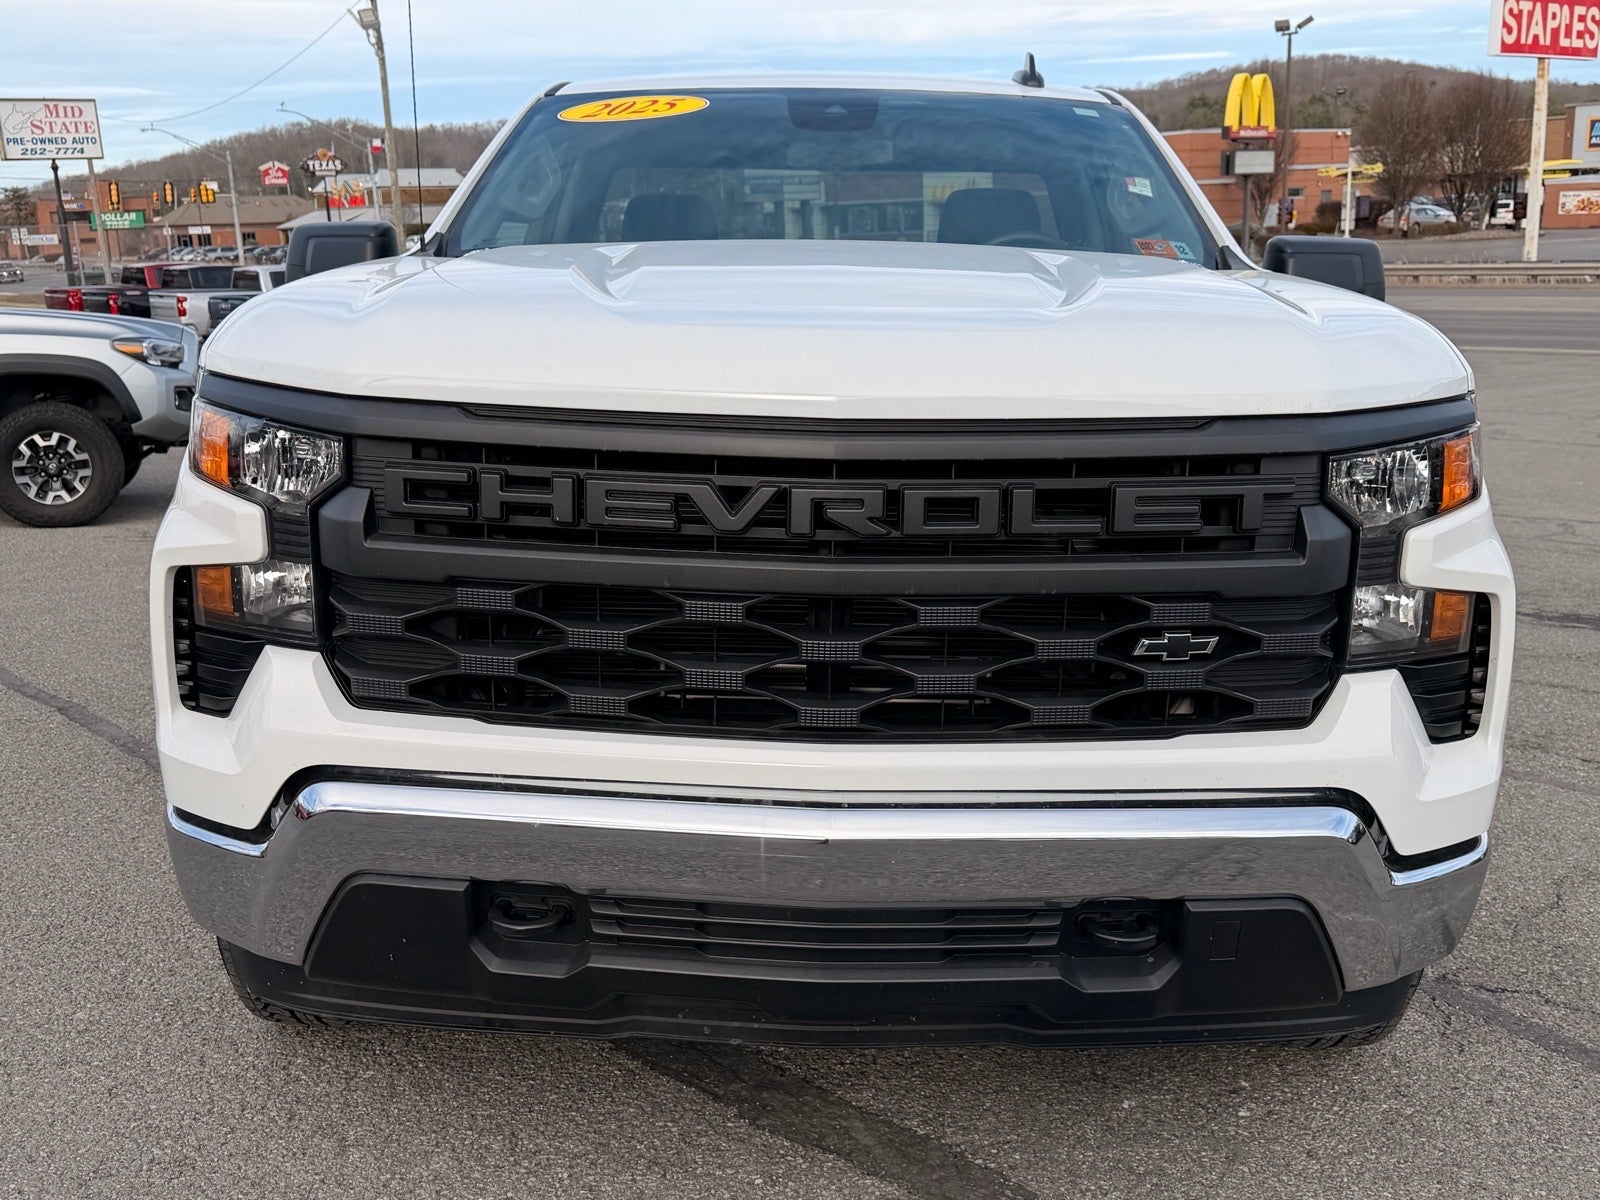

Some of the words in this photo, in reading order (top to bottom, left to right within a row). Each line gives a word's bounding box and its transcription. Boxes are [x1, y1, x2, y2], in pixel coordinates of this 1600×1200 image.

[1502, 0, 1600, 49] STAPLES
[579, 98, 686, 119] 2025
[6, 137, 67, 146] PRE-OWNED
[71, 137, 97, 145] AUTO
[20, 147, 85, 156] 252-7774
[307, 160, 342, 172] TEXAS
[384, 468, 1297, 537] CHEVROLET
